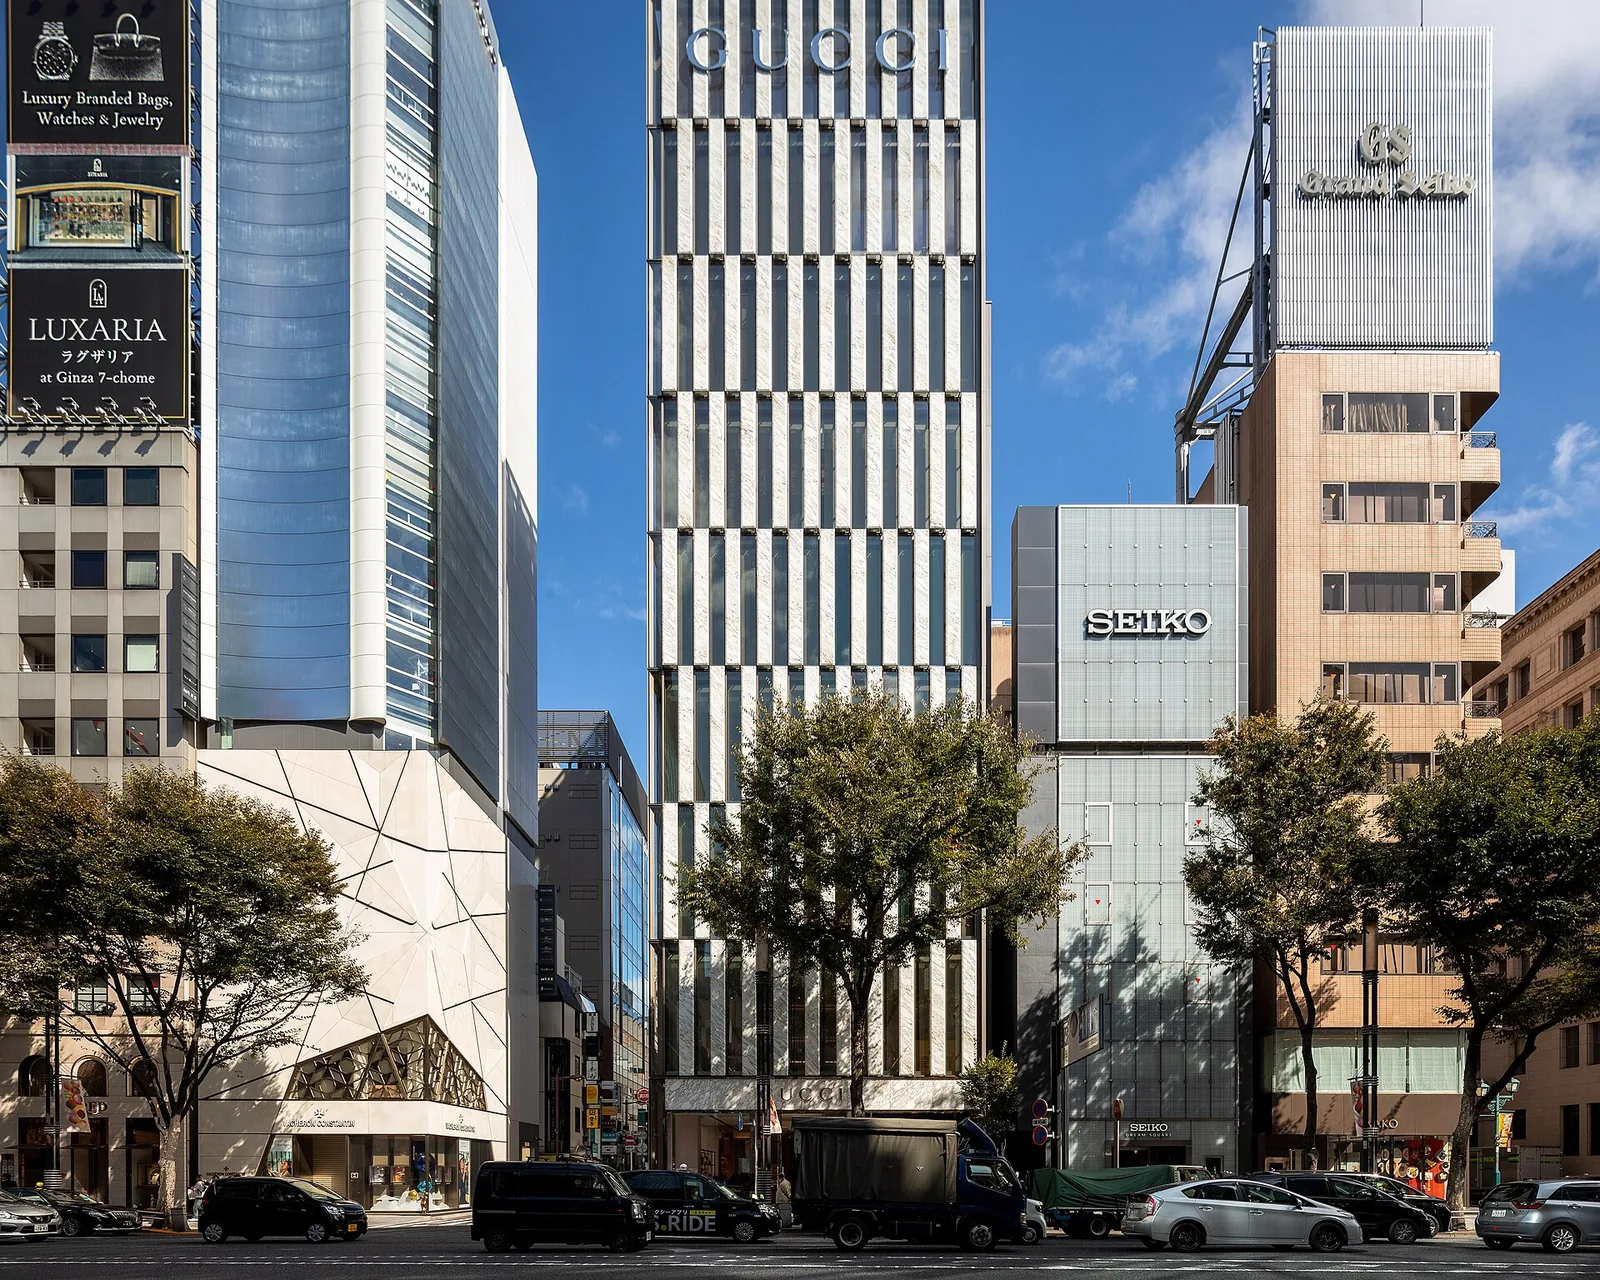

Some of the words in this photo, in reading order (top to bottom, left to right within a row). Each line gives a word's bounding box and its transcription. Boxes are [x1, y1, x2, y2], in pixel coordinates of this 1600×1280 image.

[685, 27, 949, 71] GUCCI
[22, 90, 71, 109] Luxury
[76, 91, 132, 106] Branded
[137, 92, 173, 110] Bags,
[37, 111, 95, 125] Watches
[100, 114, 109, 125] &
[112, 111, 164, 130] Jewelry
[1300, 169, 1390, 197] Grand
[1396, 170, 1476, 199] Seiko
[28, 318, 167, 341] LUXARIA
[61, 349, 134, 364] ラグザリア
[40, 373, 52, 384] at
[56, 371, 94, 384] Ginza
[98, 370, 155, 384] 7-chome
[1086, 607, 1213, 635] SEIKO
[769, 1087, 844, 1101] UCCI
[1130, 1123, 1168, 1131] SEIKO
